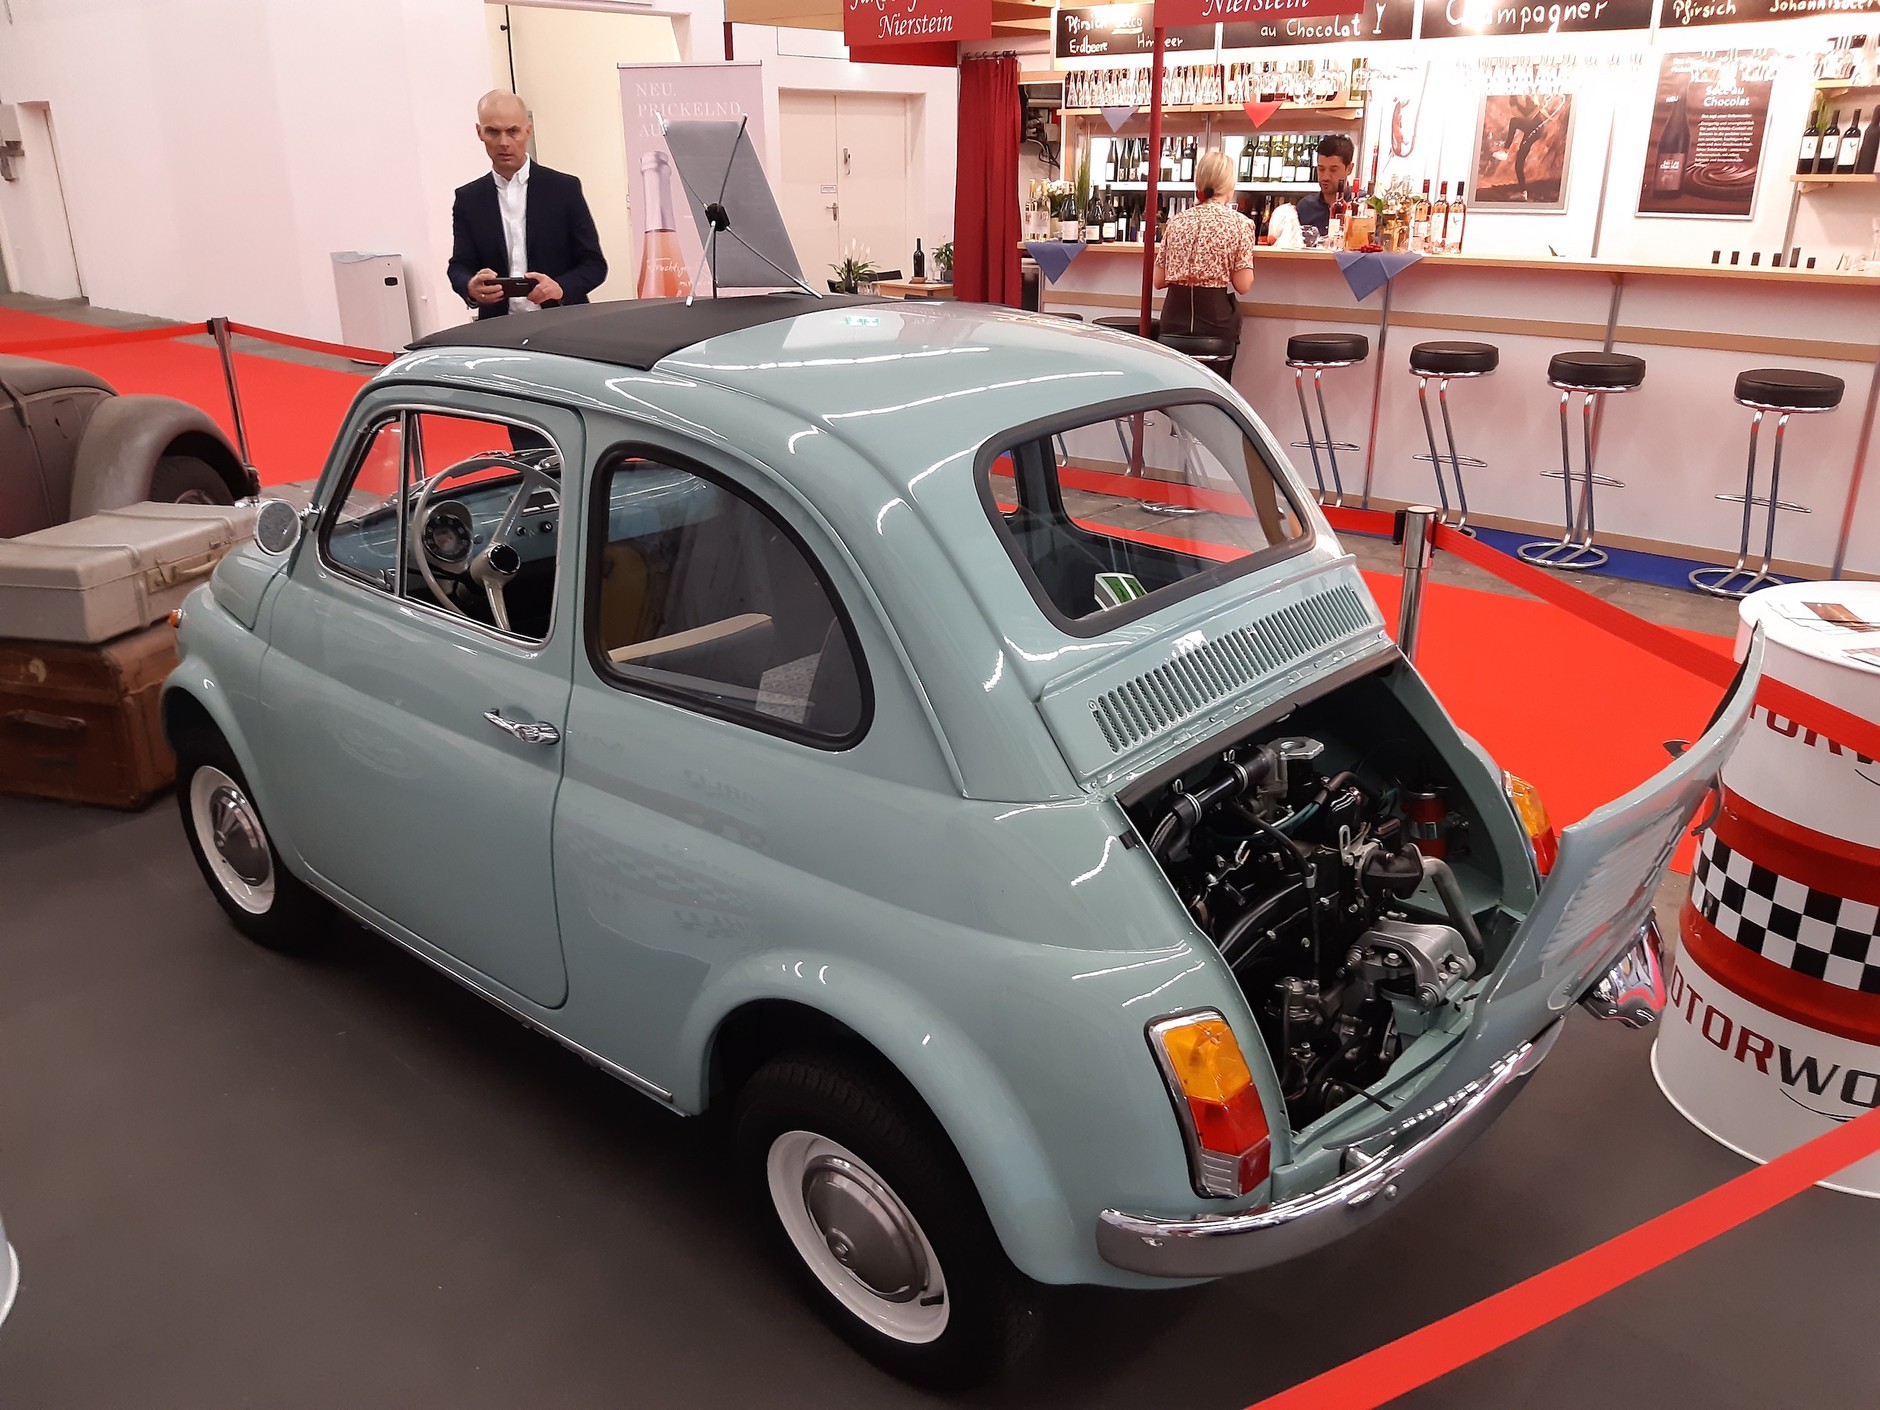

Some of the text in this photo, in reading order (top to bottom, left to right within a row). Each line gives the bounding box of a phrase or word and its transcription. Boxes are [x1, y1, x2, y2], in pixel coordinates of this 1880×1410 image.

[878, 8, 954, 38] Nierstein
[1446, 0, 1608, 33] Campagner
[1673, 0, 1737, 25] Pfirsich
[1260, 13, 1361, 38] au Chocolat
[1069, 33, 1184, 54] Erdbeere Himeer
[636, 82, 678, 97] NEU.
[1703, 96, 1750, 107] Chocolat
